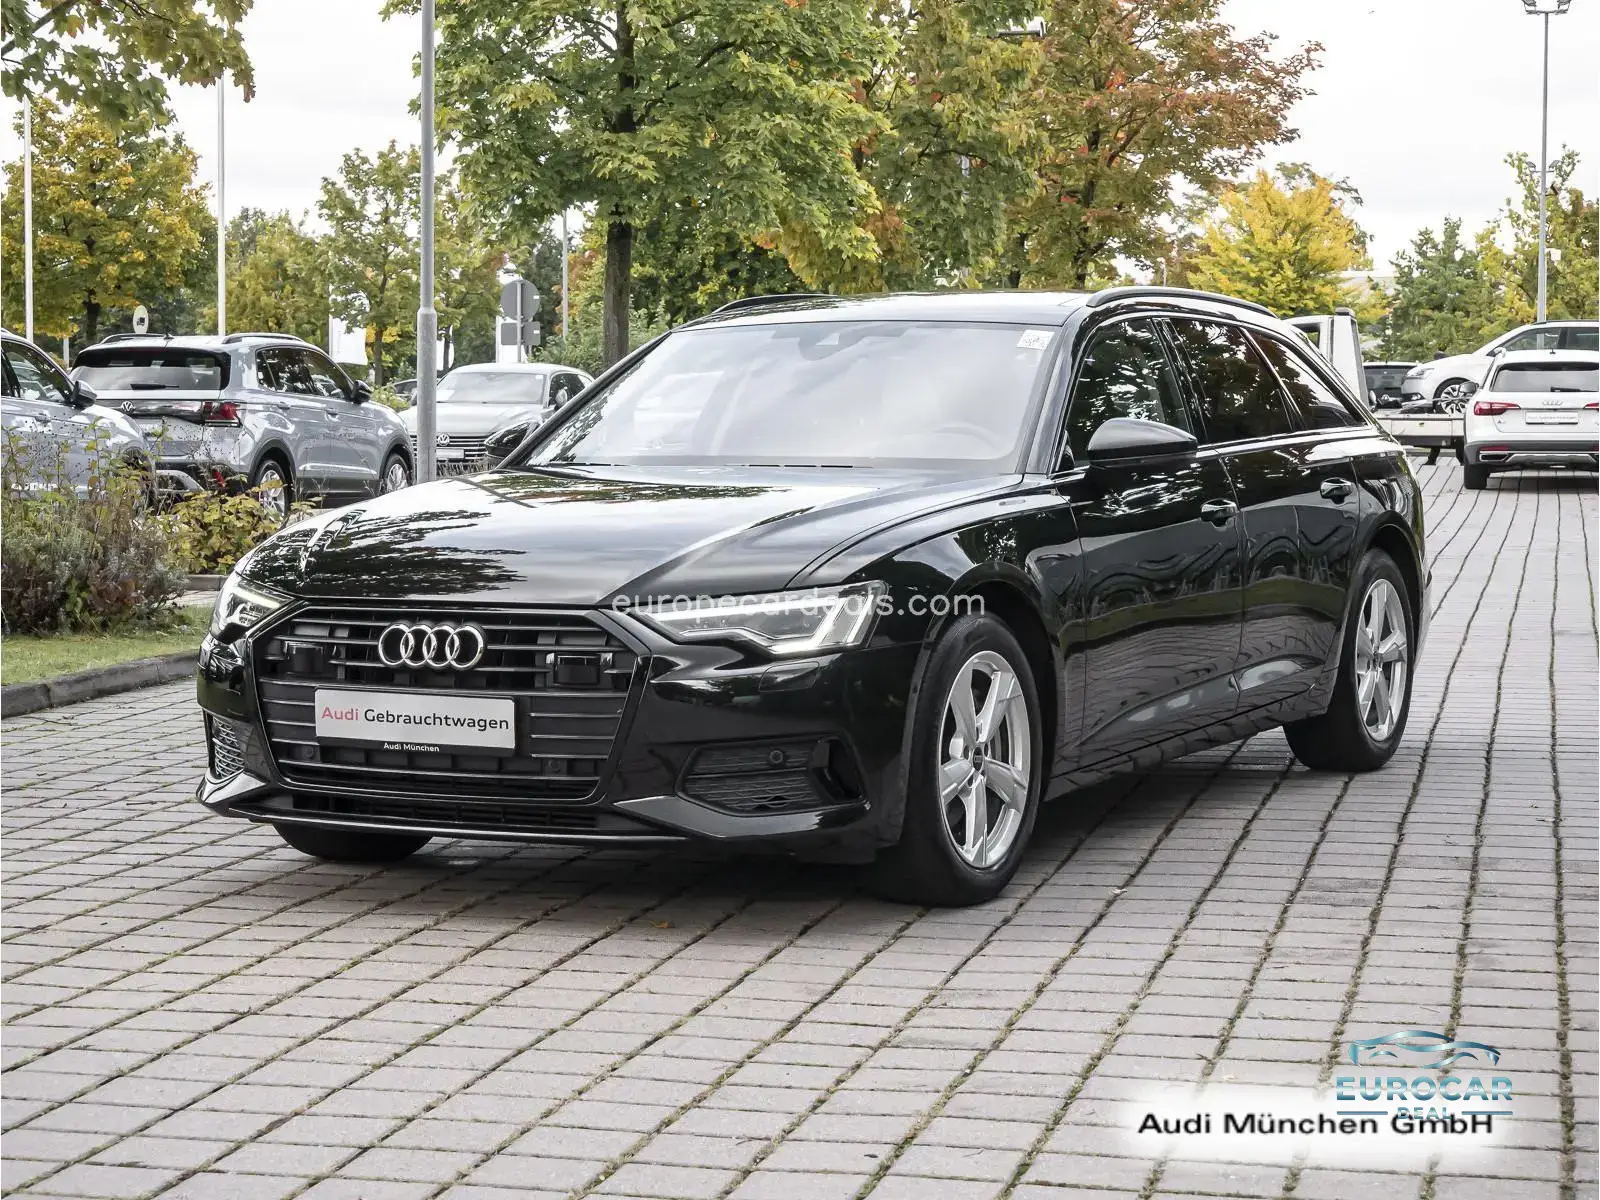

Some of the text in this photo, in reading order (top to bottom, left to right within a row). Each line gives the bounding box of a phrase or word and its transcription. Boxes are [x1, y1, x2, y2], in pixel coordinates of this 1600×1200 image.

[321, 706, 510, 732] Audi Gebrauchtwagen
[383, 742, 440, 752] Audi München
